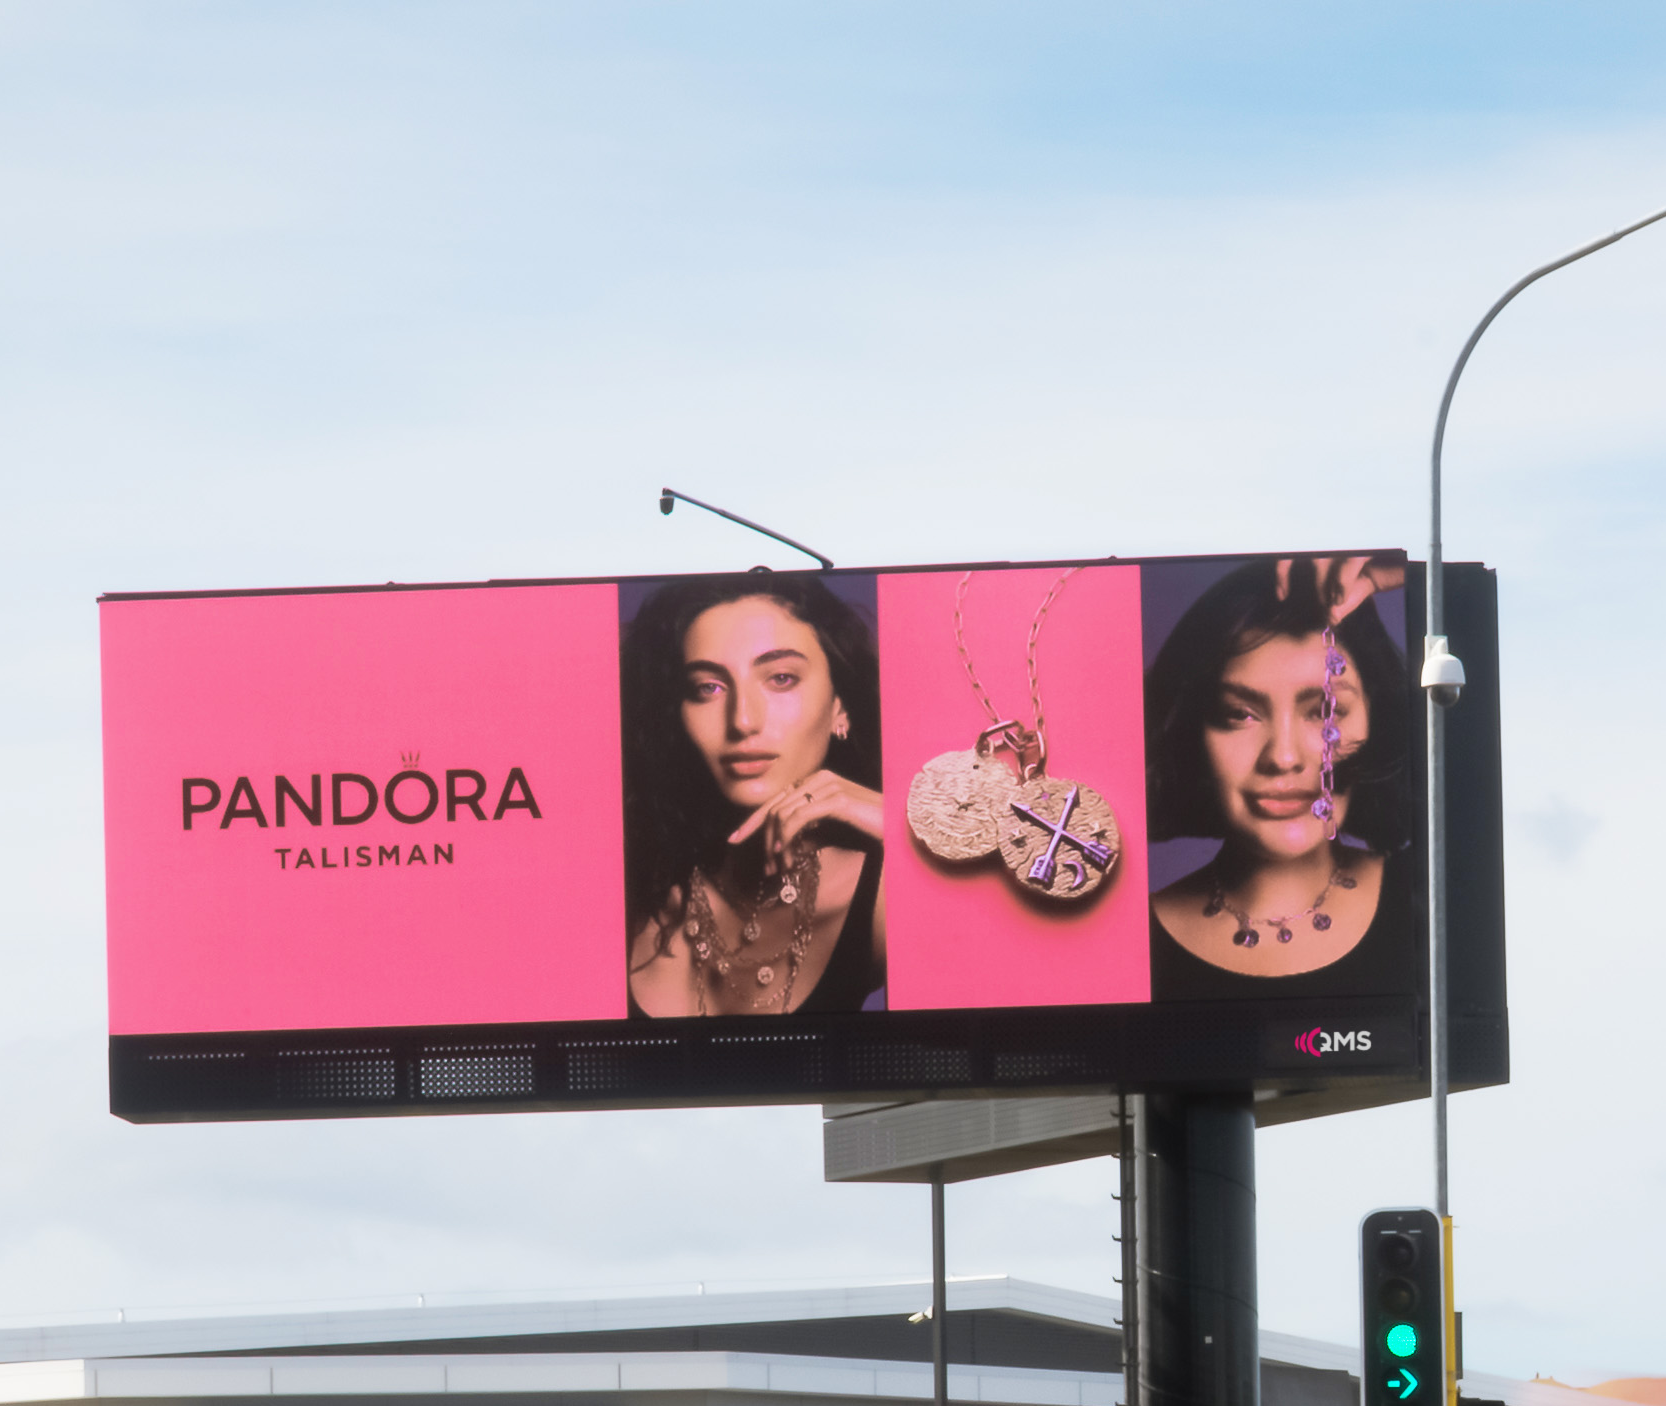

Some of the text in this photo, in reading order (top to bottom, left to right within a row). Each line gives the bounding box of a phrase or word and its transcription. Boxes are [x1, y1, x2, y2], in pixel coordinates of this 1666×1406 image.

[181, 766, 543, 831] PANDORA
[275, 843, 455, 870] TALISMAN
[1306, 1027, 1372, 1057] QMS
